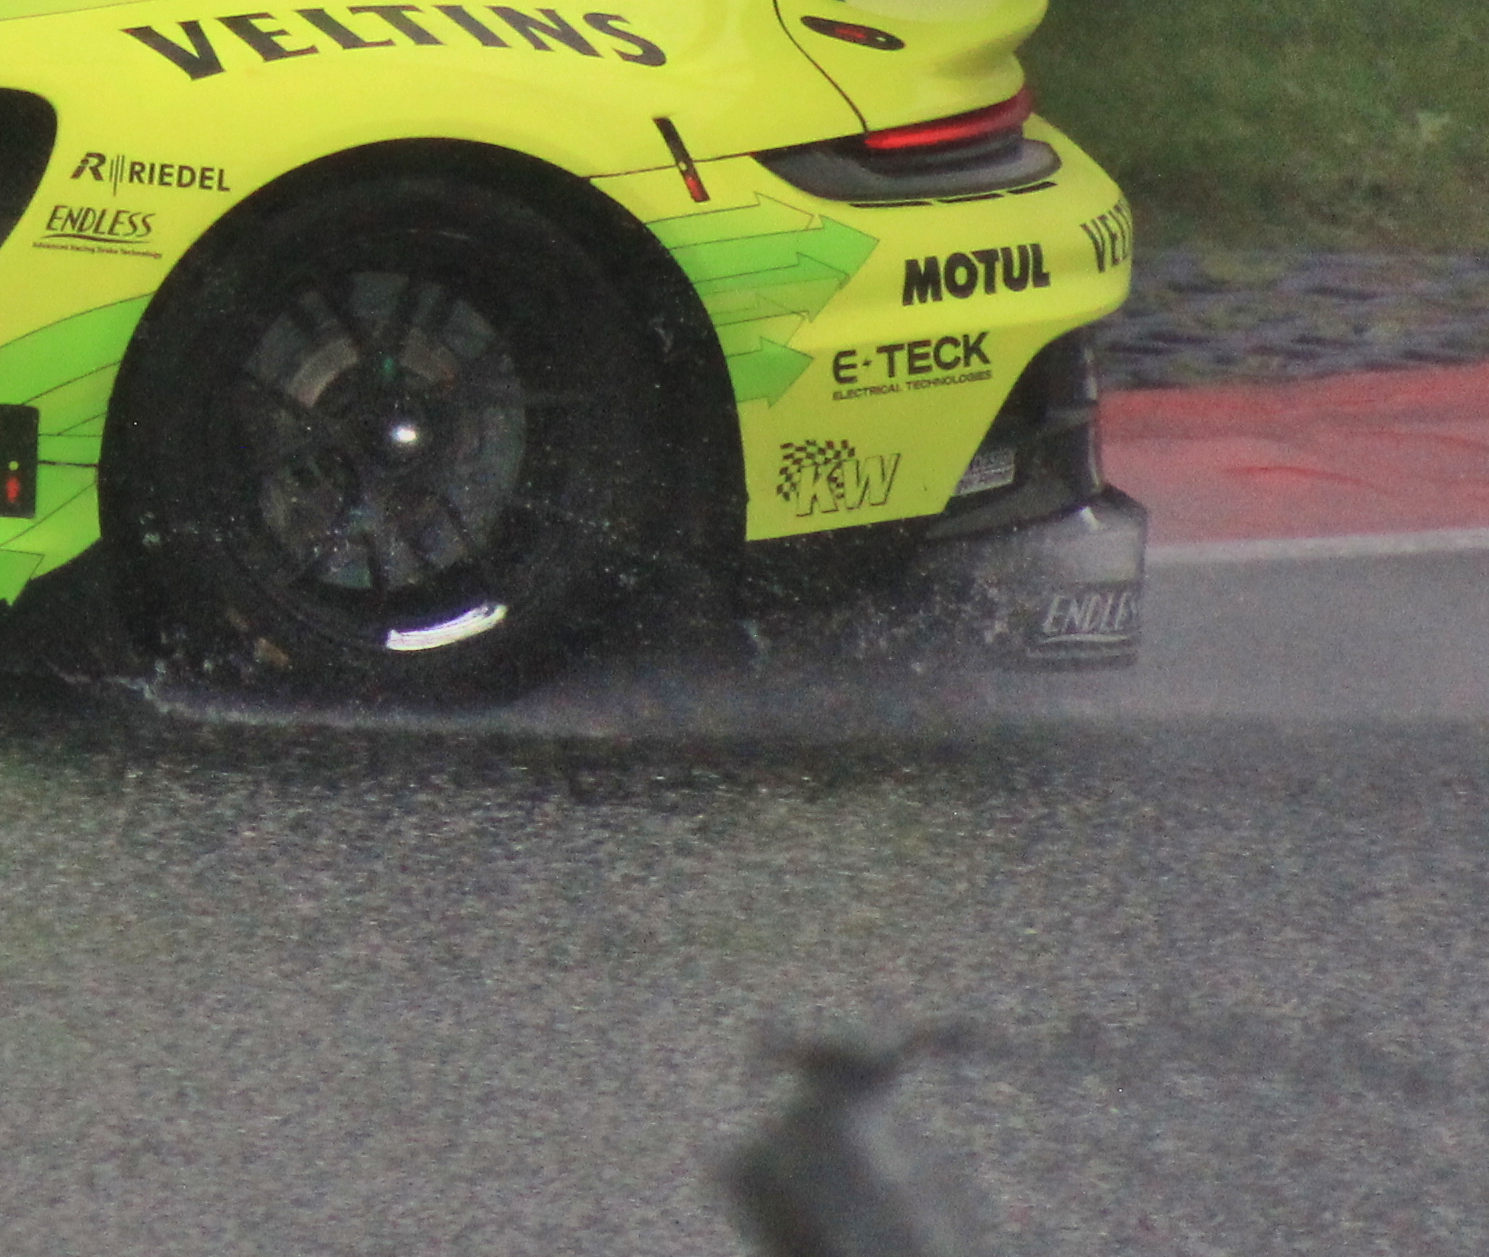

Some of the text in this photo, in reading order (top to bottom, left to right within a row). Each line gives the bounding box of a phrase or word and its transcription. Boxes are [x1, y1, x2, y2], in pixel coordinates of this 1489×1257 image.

[120, 4, 668, 82] VELTINS
[128, 161, 231, 192] RIEDEL
[45, 204, 156, 237] ENDLESS
[901, 243, 1051, 306] MOTUL
[832, 369, 993, 402] ELECTRICAL TECHNOLOGIES
[787, 447, 901, 517] KW
